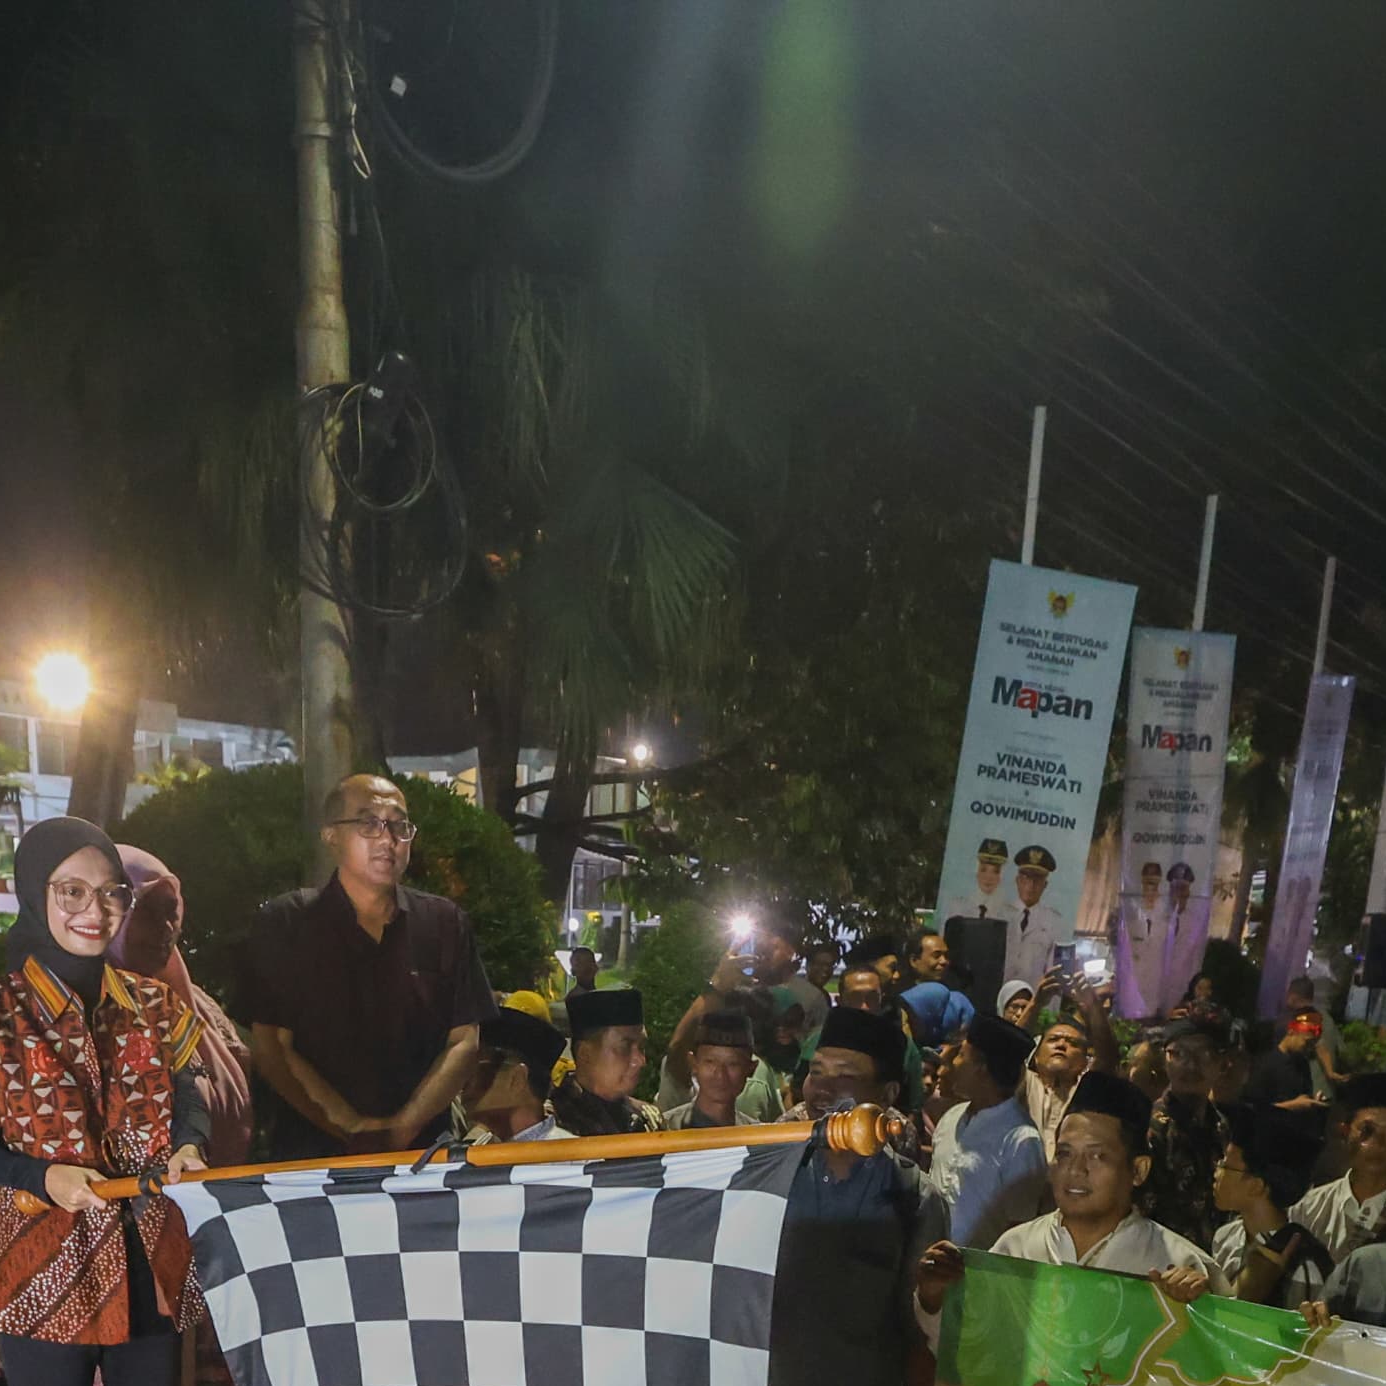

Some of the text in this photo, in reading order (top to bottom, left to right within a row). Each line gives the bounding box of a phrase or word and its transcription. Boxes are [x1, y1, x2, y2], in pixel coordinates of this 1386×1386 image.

[991, 675, 1094, 721] Mapan
[1141, 724, 1212, 756] Mapan
[977, 764, 1082, 794] PRAMESWATI
[996, 752, 1068, 777] VINANDA
[970, 801, 1077, 830] QOWIMUDDIN
